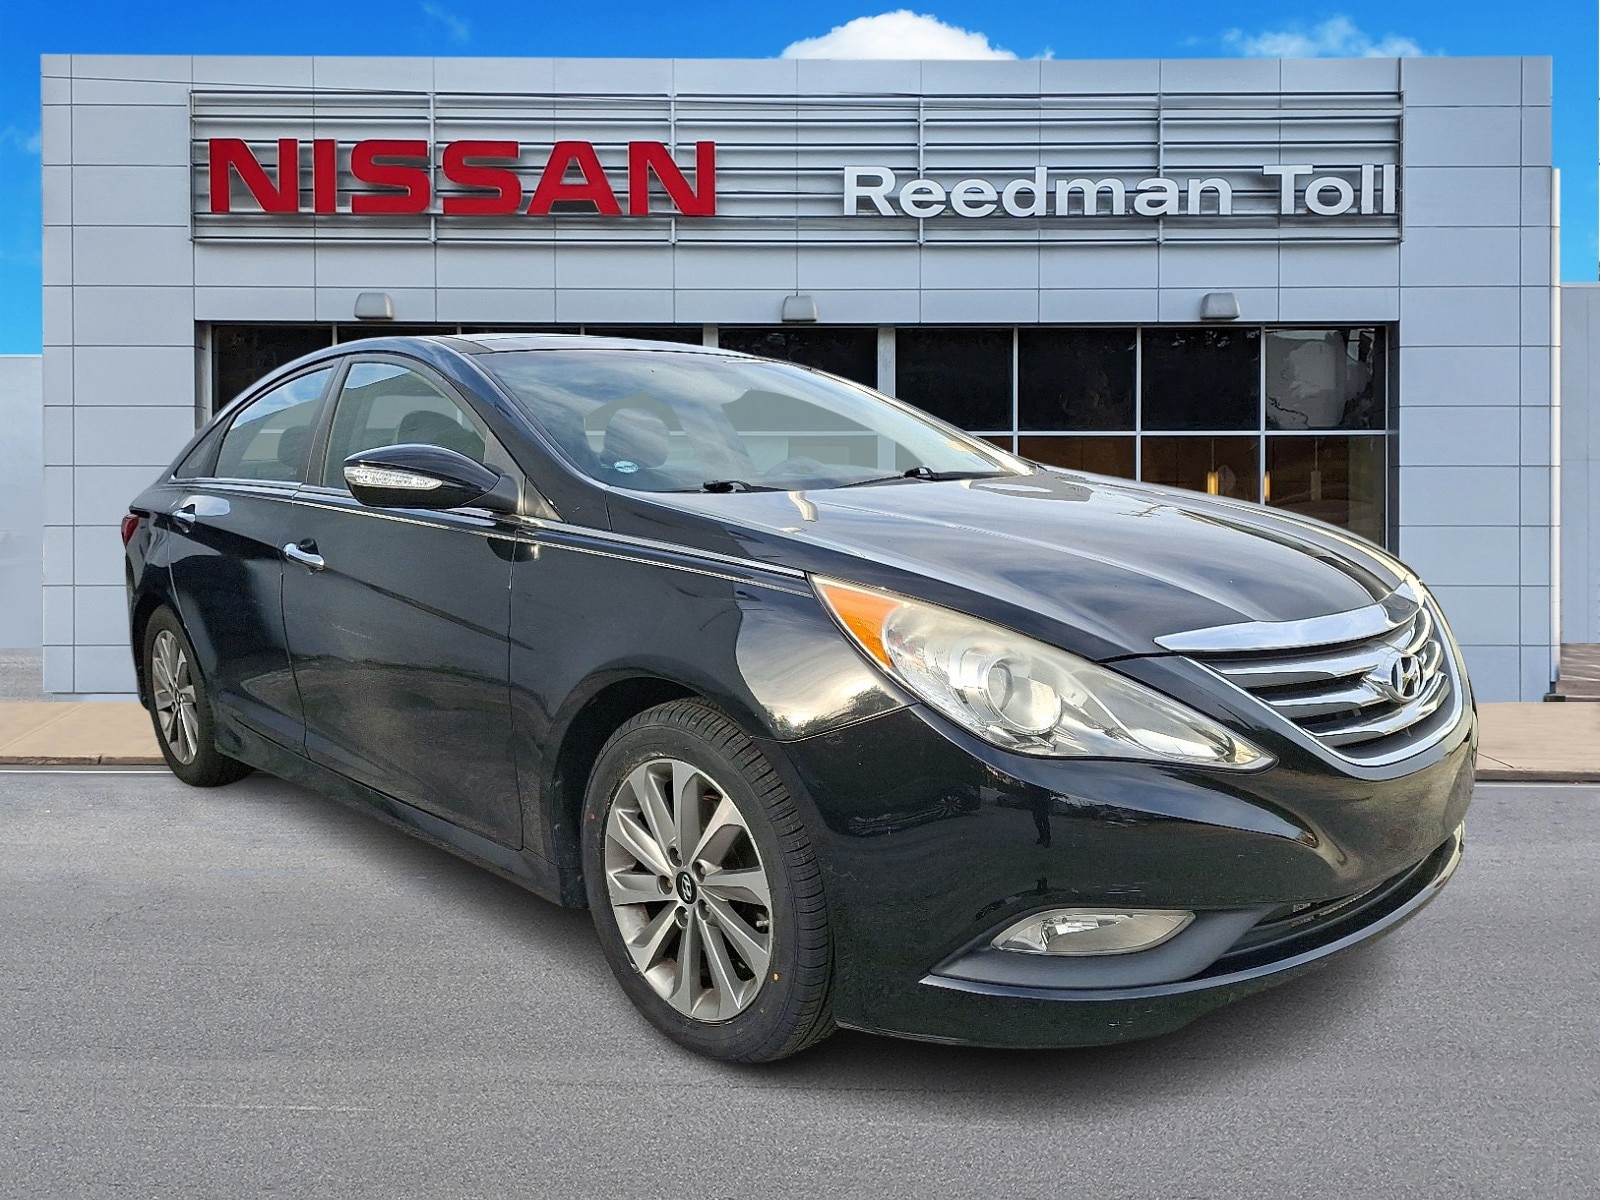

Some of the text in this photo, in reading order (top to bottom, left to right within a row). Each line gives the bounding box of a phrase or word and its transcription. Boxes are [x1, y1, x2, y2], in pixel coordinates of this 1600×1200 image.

[208, 138, 716, 216] NISSAN
[843, 164, 1396, 218] Reedman Toll
